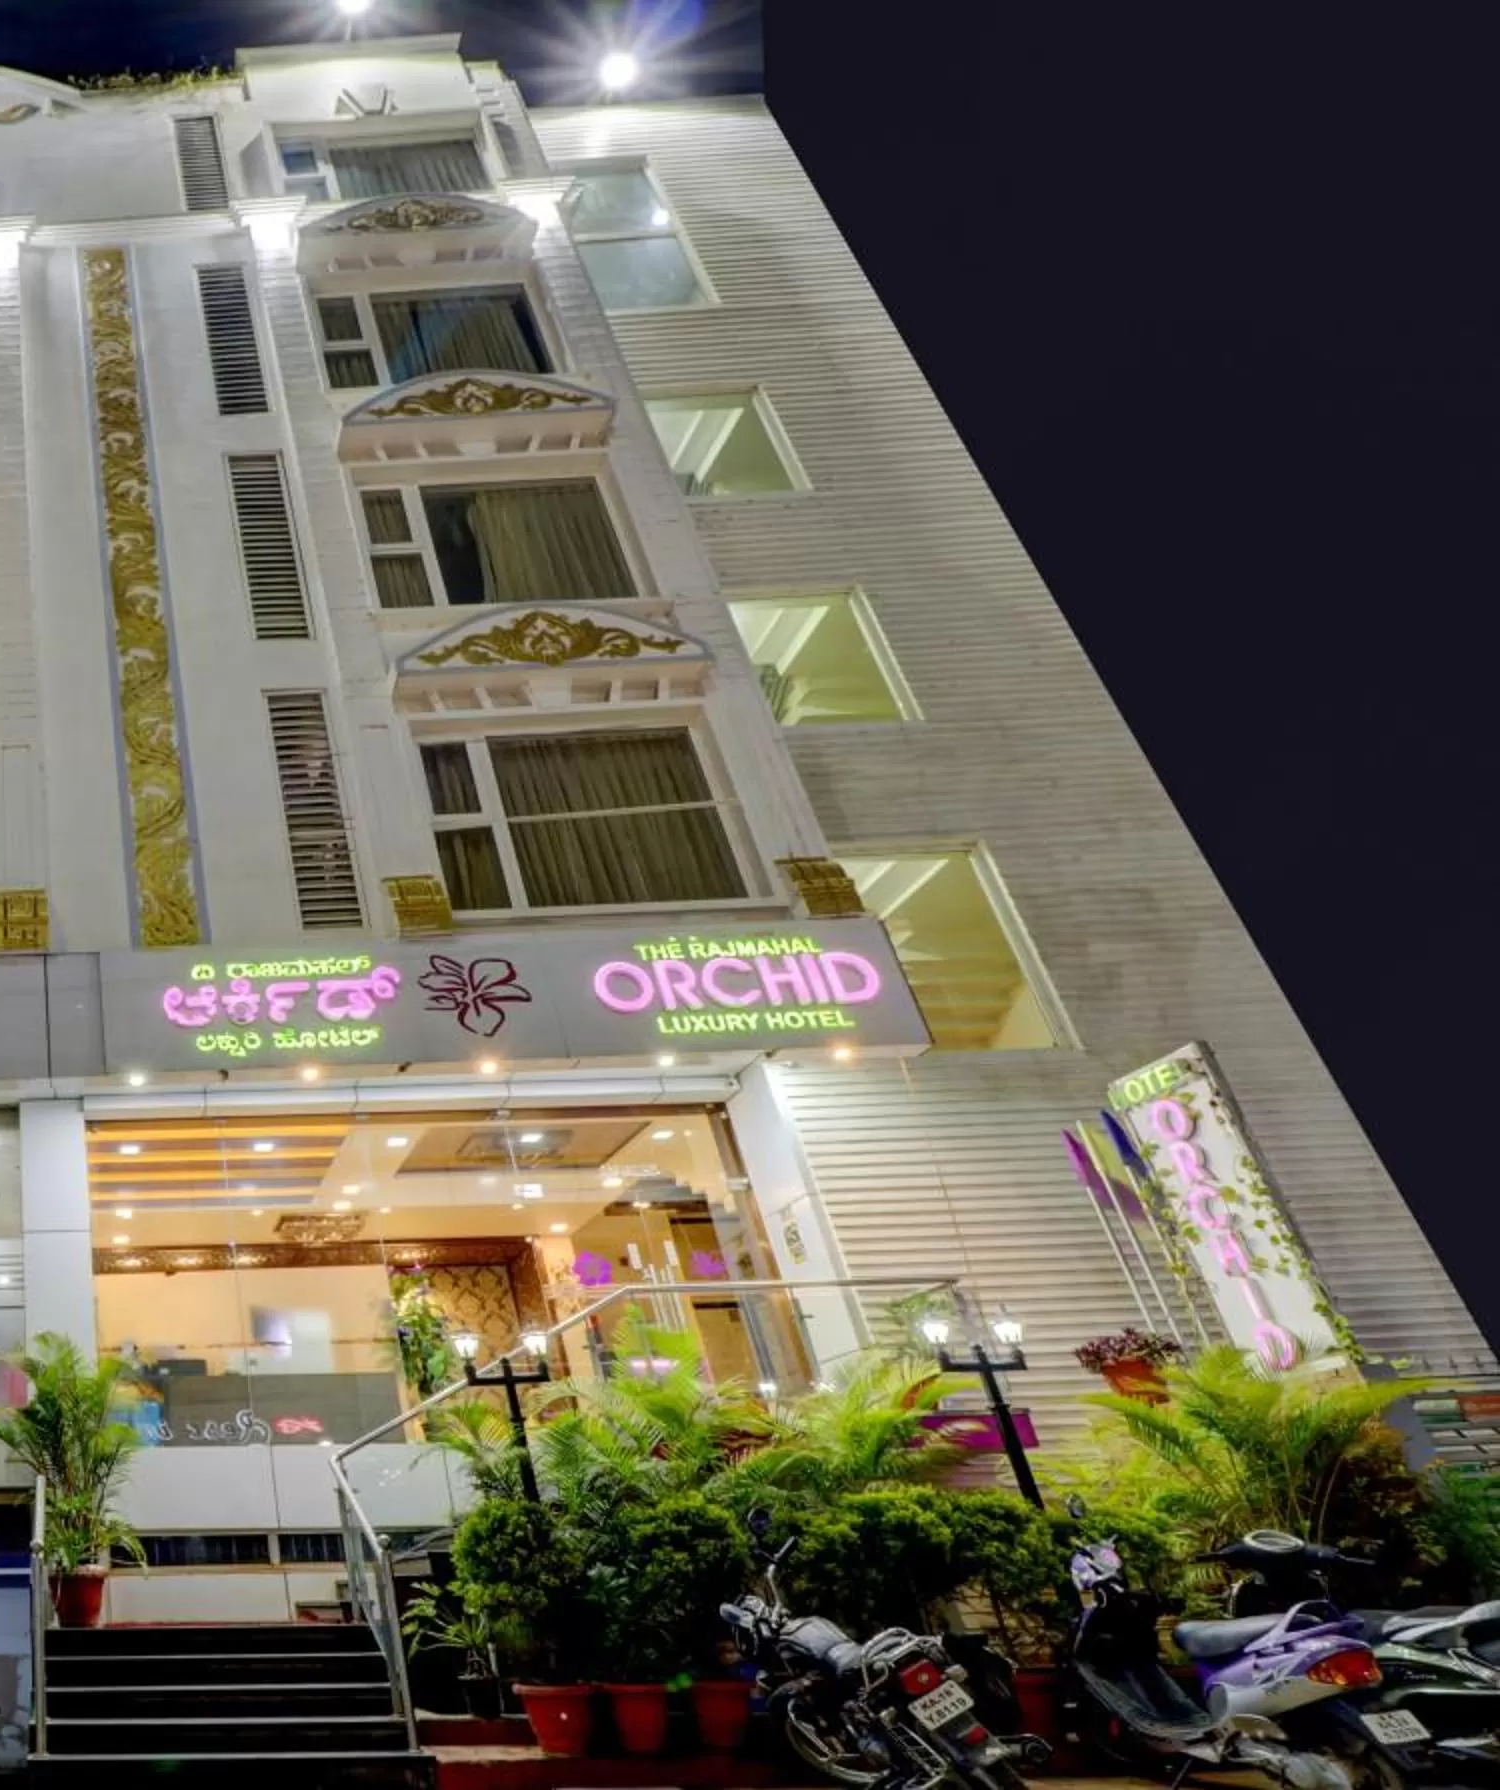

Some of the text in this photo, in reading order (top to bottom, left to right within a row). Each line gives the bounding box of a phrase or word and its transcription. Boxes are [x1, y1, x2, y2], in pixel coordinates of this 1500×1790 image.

[633, 937, 823, 961] THE RAJMAHAL
[593, 952, 881, 1014] ORCHID
[657, 1009, 855, 1034] LUXURY HOTEL
